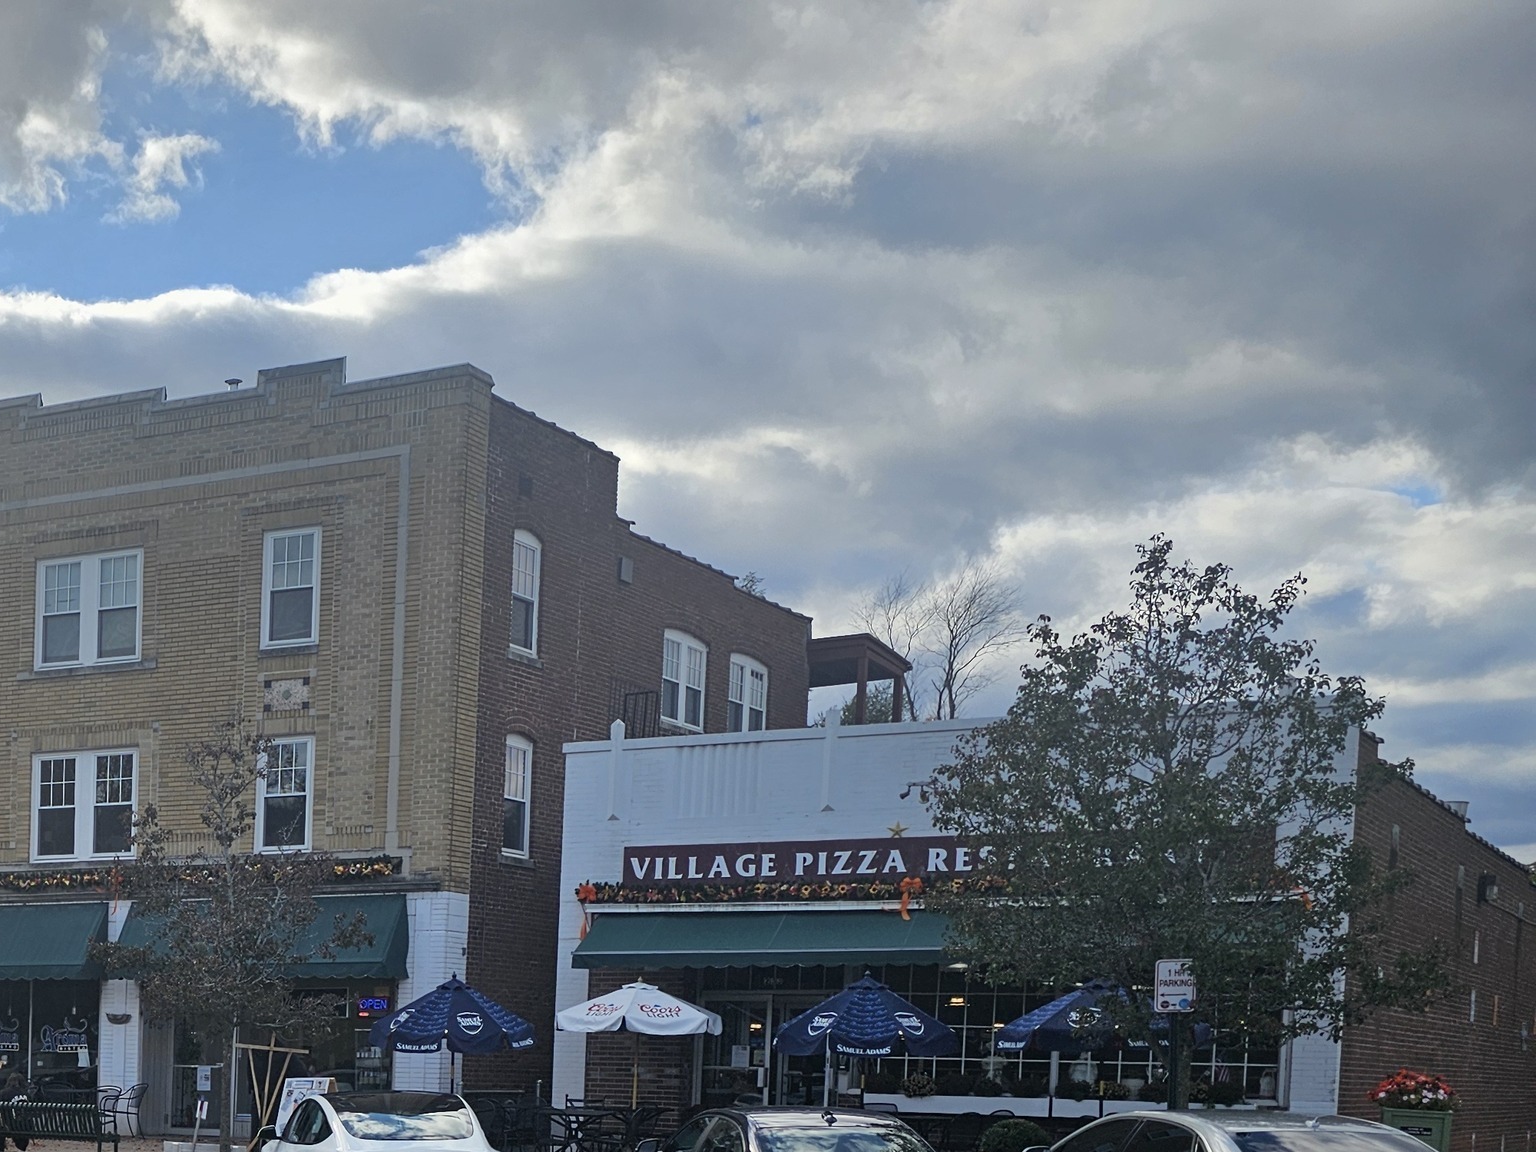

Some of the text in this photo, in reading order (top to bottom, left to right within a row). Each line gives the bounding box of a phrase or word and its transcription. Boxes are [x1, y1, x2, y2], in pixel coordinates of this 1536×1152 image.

[630, 853, 777, 881] VILLAGE
[794, 849, 907, 877] PIZZA
[1159, 979, 1193, 988] PARKING
[359, 999, 387, 1010] OPEN
[637, 1003, 682, 1014] Coors
[396, 1042, 419, 1050] SAMUEL
[836, 1043, 892, 1055] SAMUEL ADAMS
